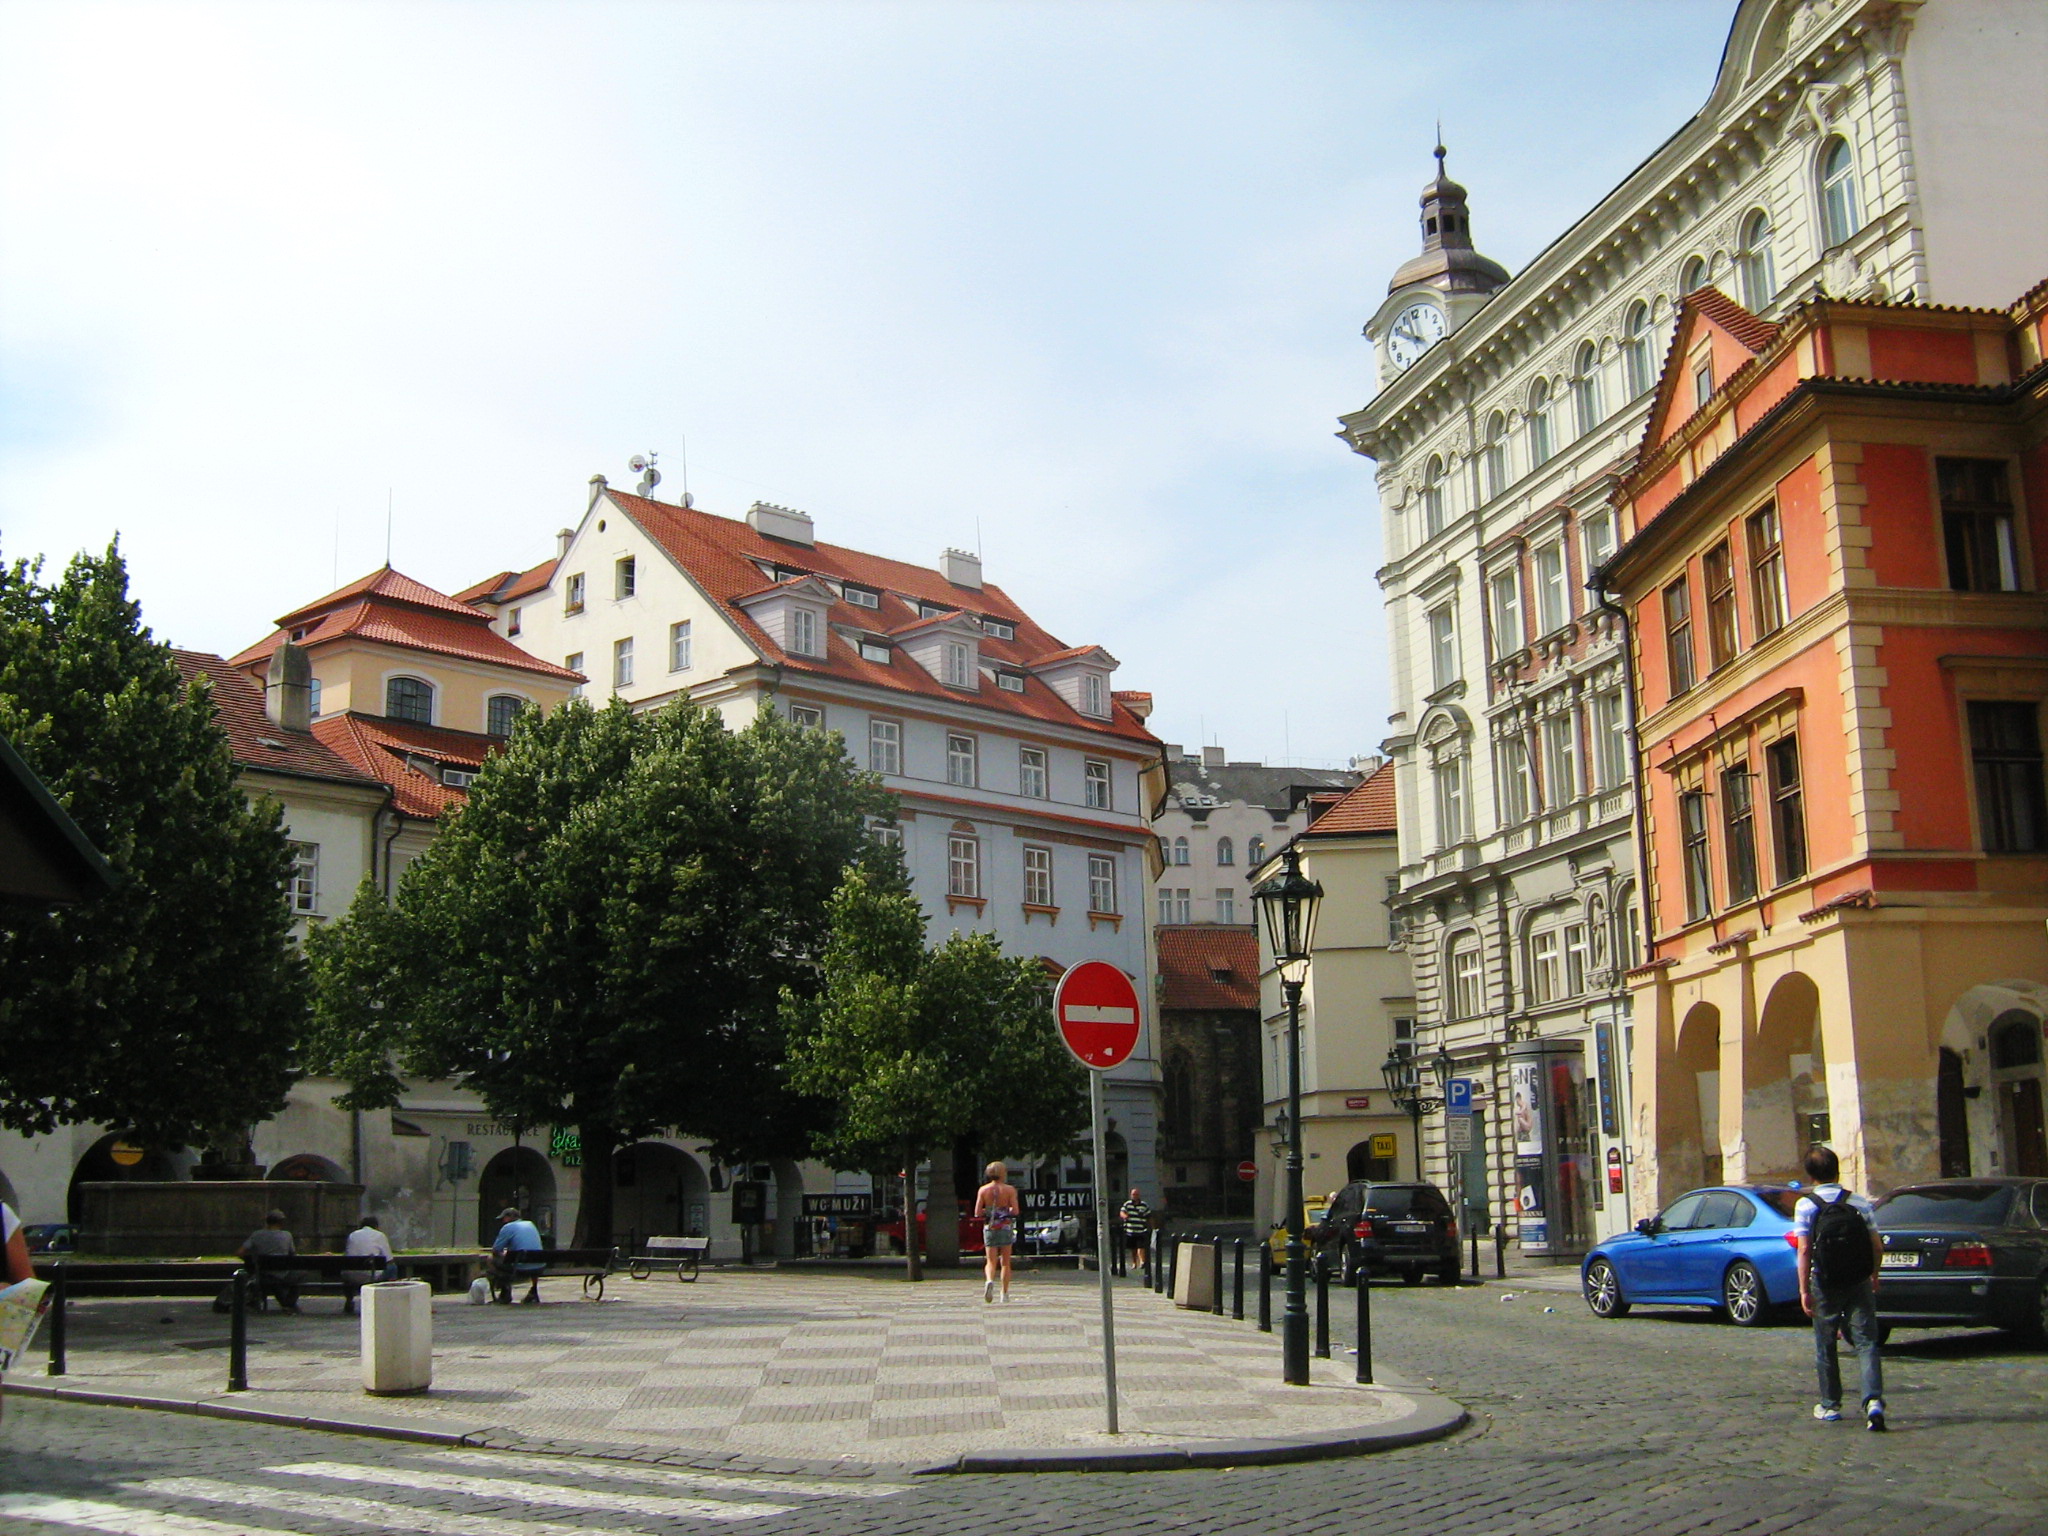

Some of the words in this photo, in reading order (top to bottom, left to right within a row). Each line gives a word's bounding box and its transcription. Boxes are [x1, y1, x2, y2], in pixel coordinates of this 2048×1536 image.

[1411, 308, 1420, 320] 12
[1432, 313, 1438, 324] 2
[1437, 326, 1443, 336] 3
[1391, 341, 1397, 351] 9
[1396, 352, 1402, 362] 8
[1451, 1083, 1466, 1103] P
[467, 1123, 539, 1136] RESTAUACE
[1376, 1141, 1391, 1150] TAXI
[1025, 1194, 1045, 1207] WC
[1049, 1190, 1085, 1207] ŽENY
[808, 1198, 827, 1211] WC
